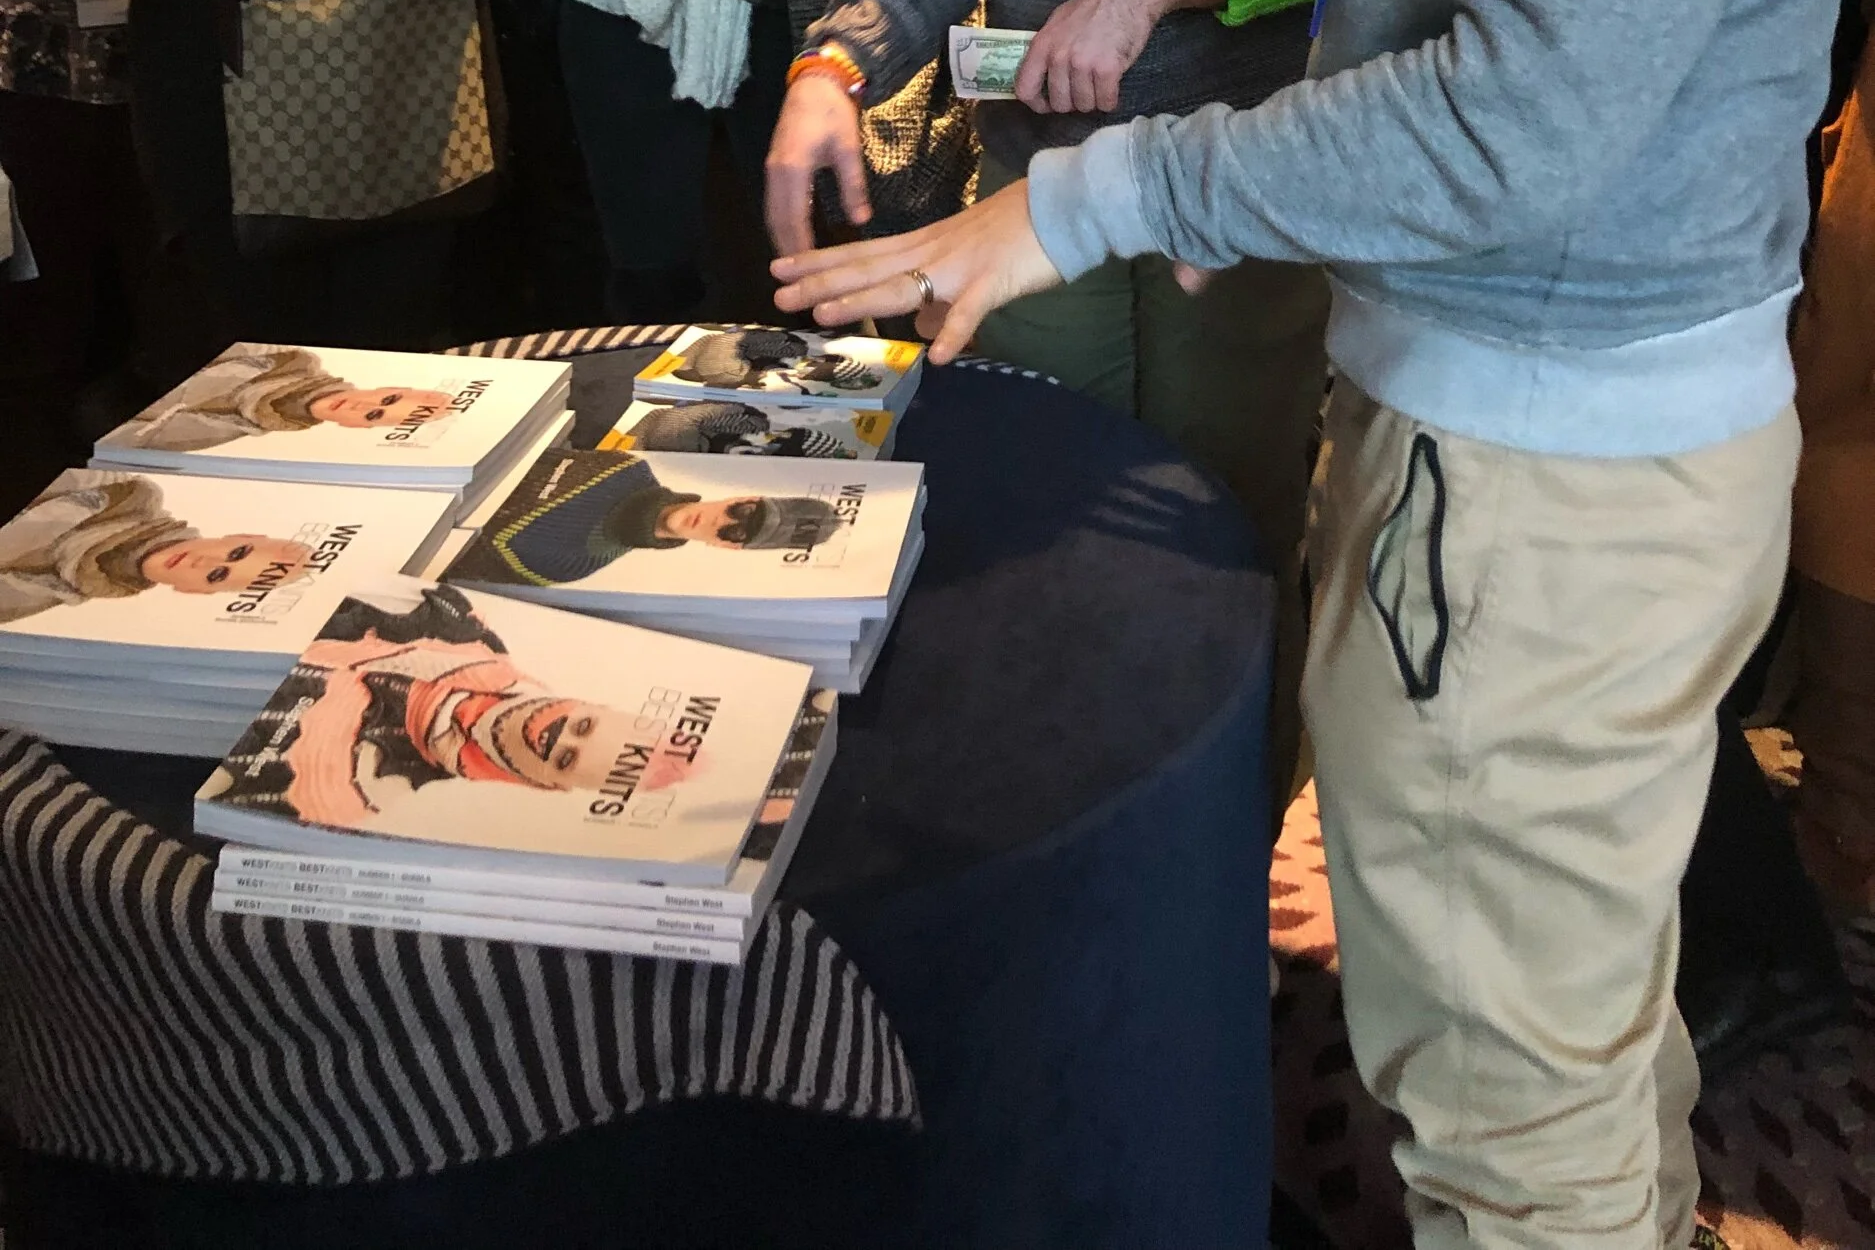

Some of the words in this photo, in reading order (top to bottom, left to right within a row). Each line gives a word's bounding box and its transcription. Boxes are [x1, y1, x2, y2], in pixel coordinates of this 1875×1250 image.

[446, 379, 494, 413] WEST
[385, 405, 439, 440] KNITS
[833, 484, 867, 526] WEST
[303, 524, 363, 573] WEST
[226, 561, 295, 613] KNITS
[664, 696, 721, 764] WEST
[589, 743, 654, 817] KNITS
